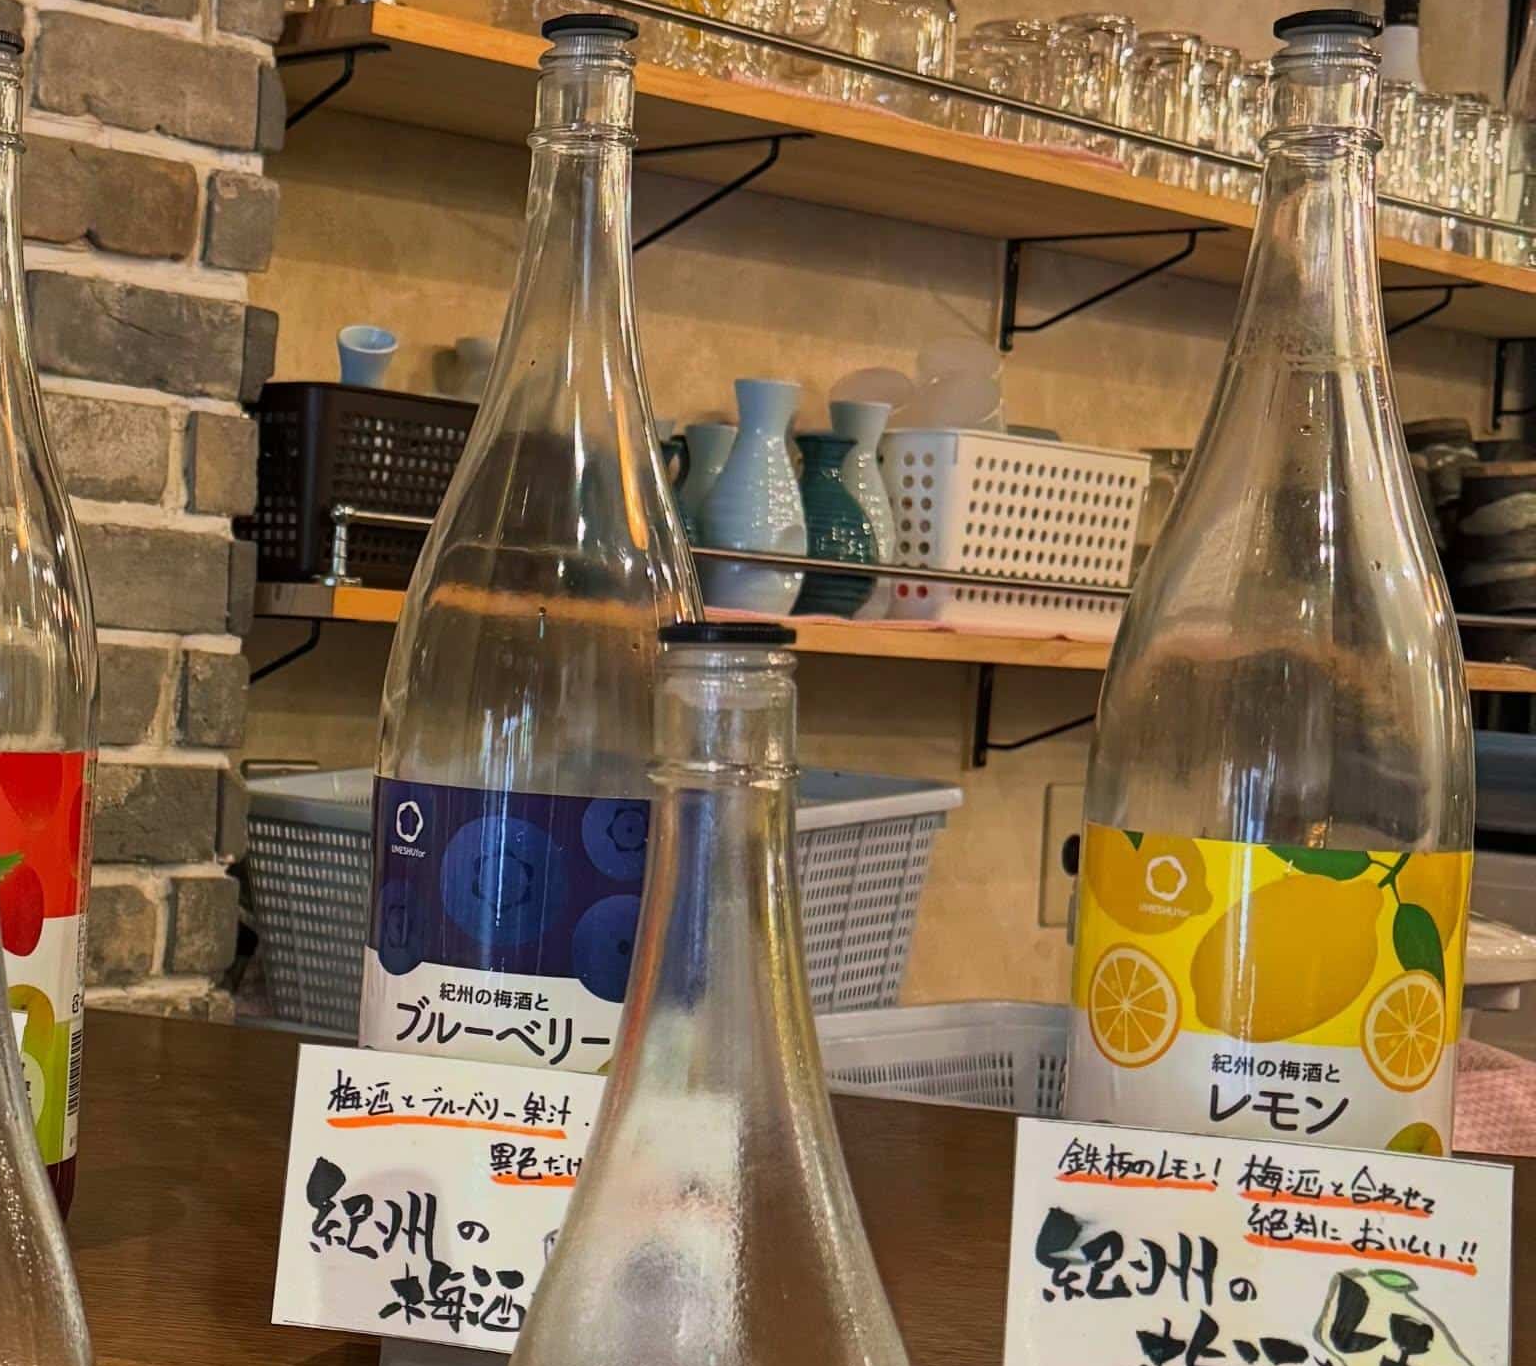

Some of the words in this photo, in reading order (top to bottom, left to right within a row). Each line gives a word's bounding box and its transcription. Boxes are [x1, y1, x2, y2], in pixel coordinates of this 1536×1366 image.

[439, 982, 550, 1012] 紀州の梅酒と
[396, 995, 611, 1066] ブルーベリー
[1212, 1052, 1341, 1085] 紀州の梅酒と
[1208, 1082, 1350, 1135] レモン
[306, 1156, 490, 1261] 紀州の
[1035, 1206, 1258, 1305] 紀州の
